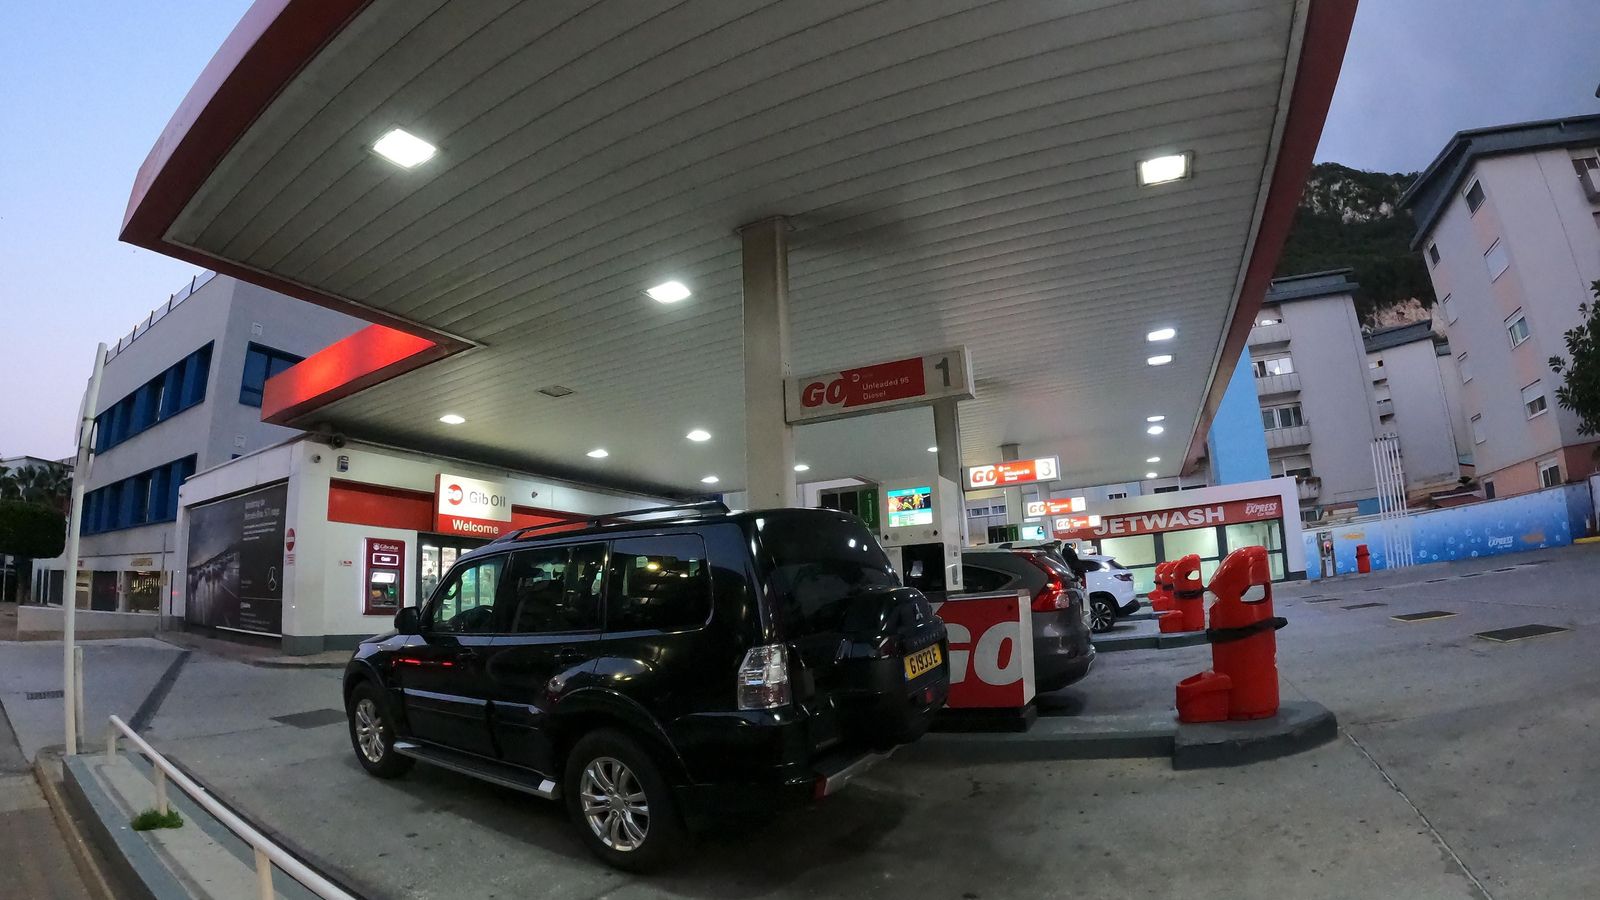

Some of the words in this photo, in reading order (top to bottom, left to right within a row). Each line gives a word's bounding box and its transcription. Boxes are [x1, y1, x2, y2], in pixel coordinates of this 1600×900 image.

[935, 357, 951, 387] 1
[862, 377, 898, 391] Unleaded
[900, 376, 910, 385] 95
[802, 378, 847, 408] GO
[863, 391, 886, 400] Diesel
[972, 469, 996, 483] GO
[1042, 461, 1052, 476] 3
[1245, 502, 1278, 514] EXPRESS
[452, 518, 499, 534] Welcome
[1093, 505, 1225, 536] JETWASH
